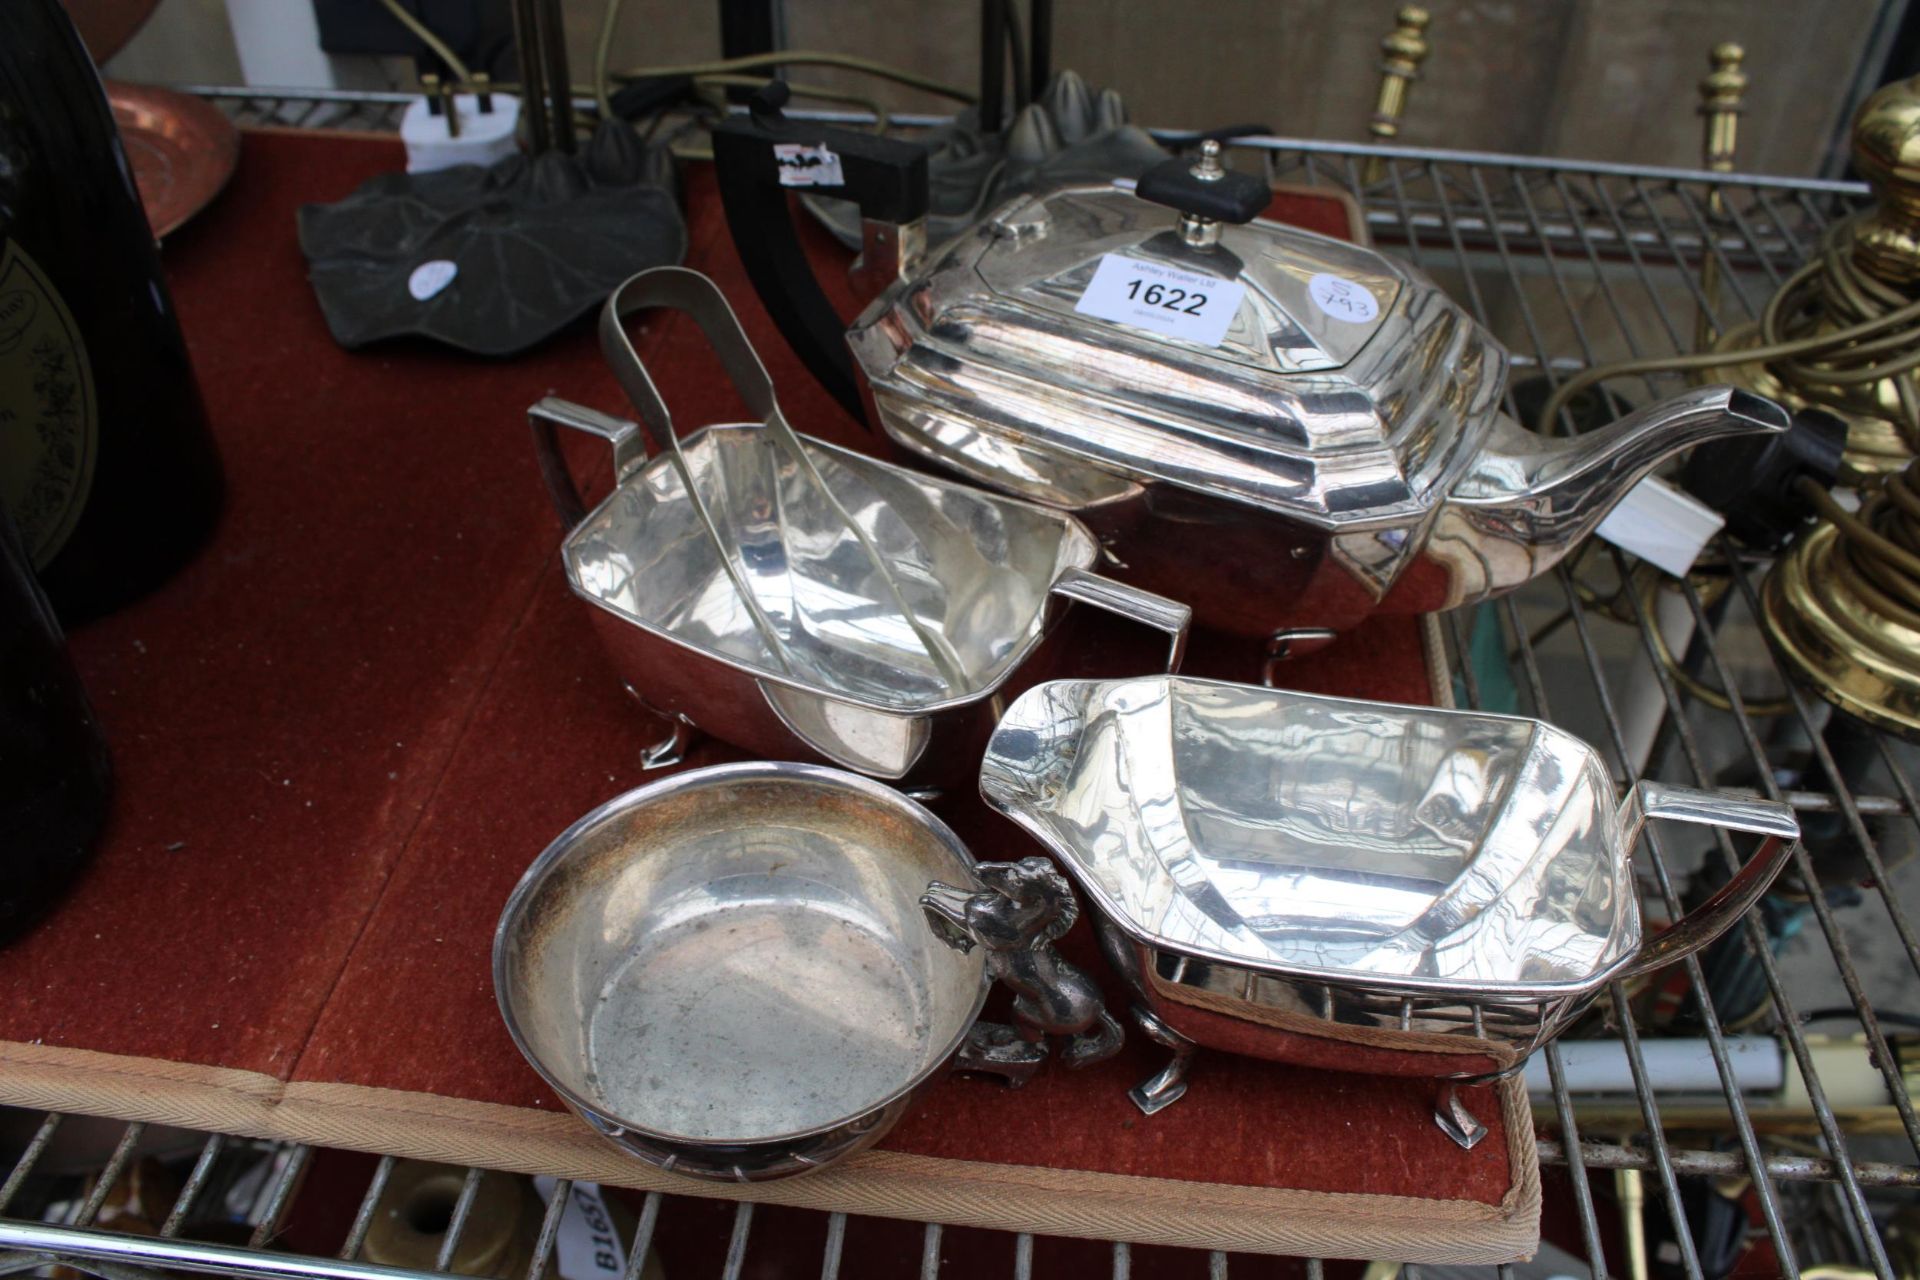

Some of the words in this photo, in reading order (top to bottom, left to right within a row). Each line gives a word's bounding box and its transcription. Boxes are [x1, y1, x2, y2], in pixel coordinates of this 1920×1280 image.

[1131, 262, 1164, 277] Ashley
[1200, 277, 1217, 290] Ltd
[1127, 278, 1208, 317] 1622
[573, 1186, 619, 1272] B1657
